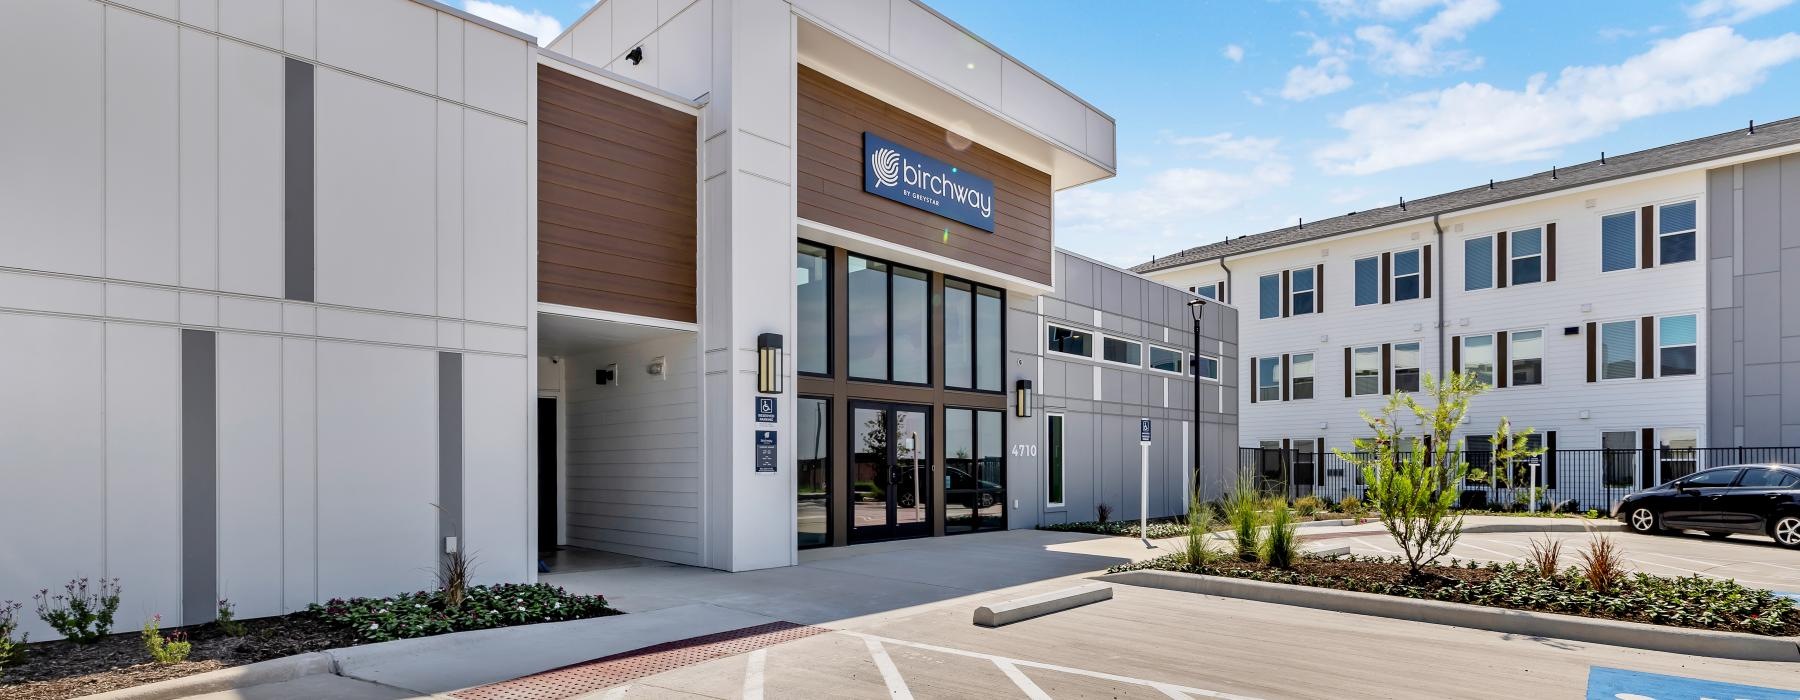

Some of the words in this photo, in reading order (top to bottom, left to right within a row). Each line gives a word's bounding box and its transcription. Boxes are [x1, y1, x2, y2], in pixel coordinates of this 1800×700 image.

[903, 158, 991, 218] birchway
[912, 192, 940, 206] GREYSTAR
[1011, 444, 1037, 457] 4710
